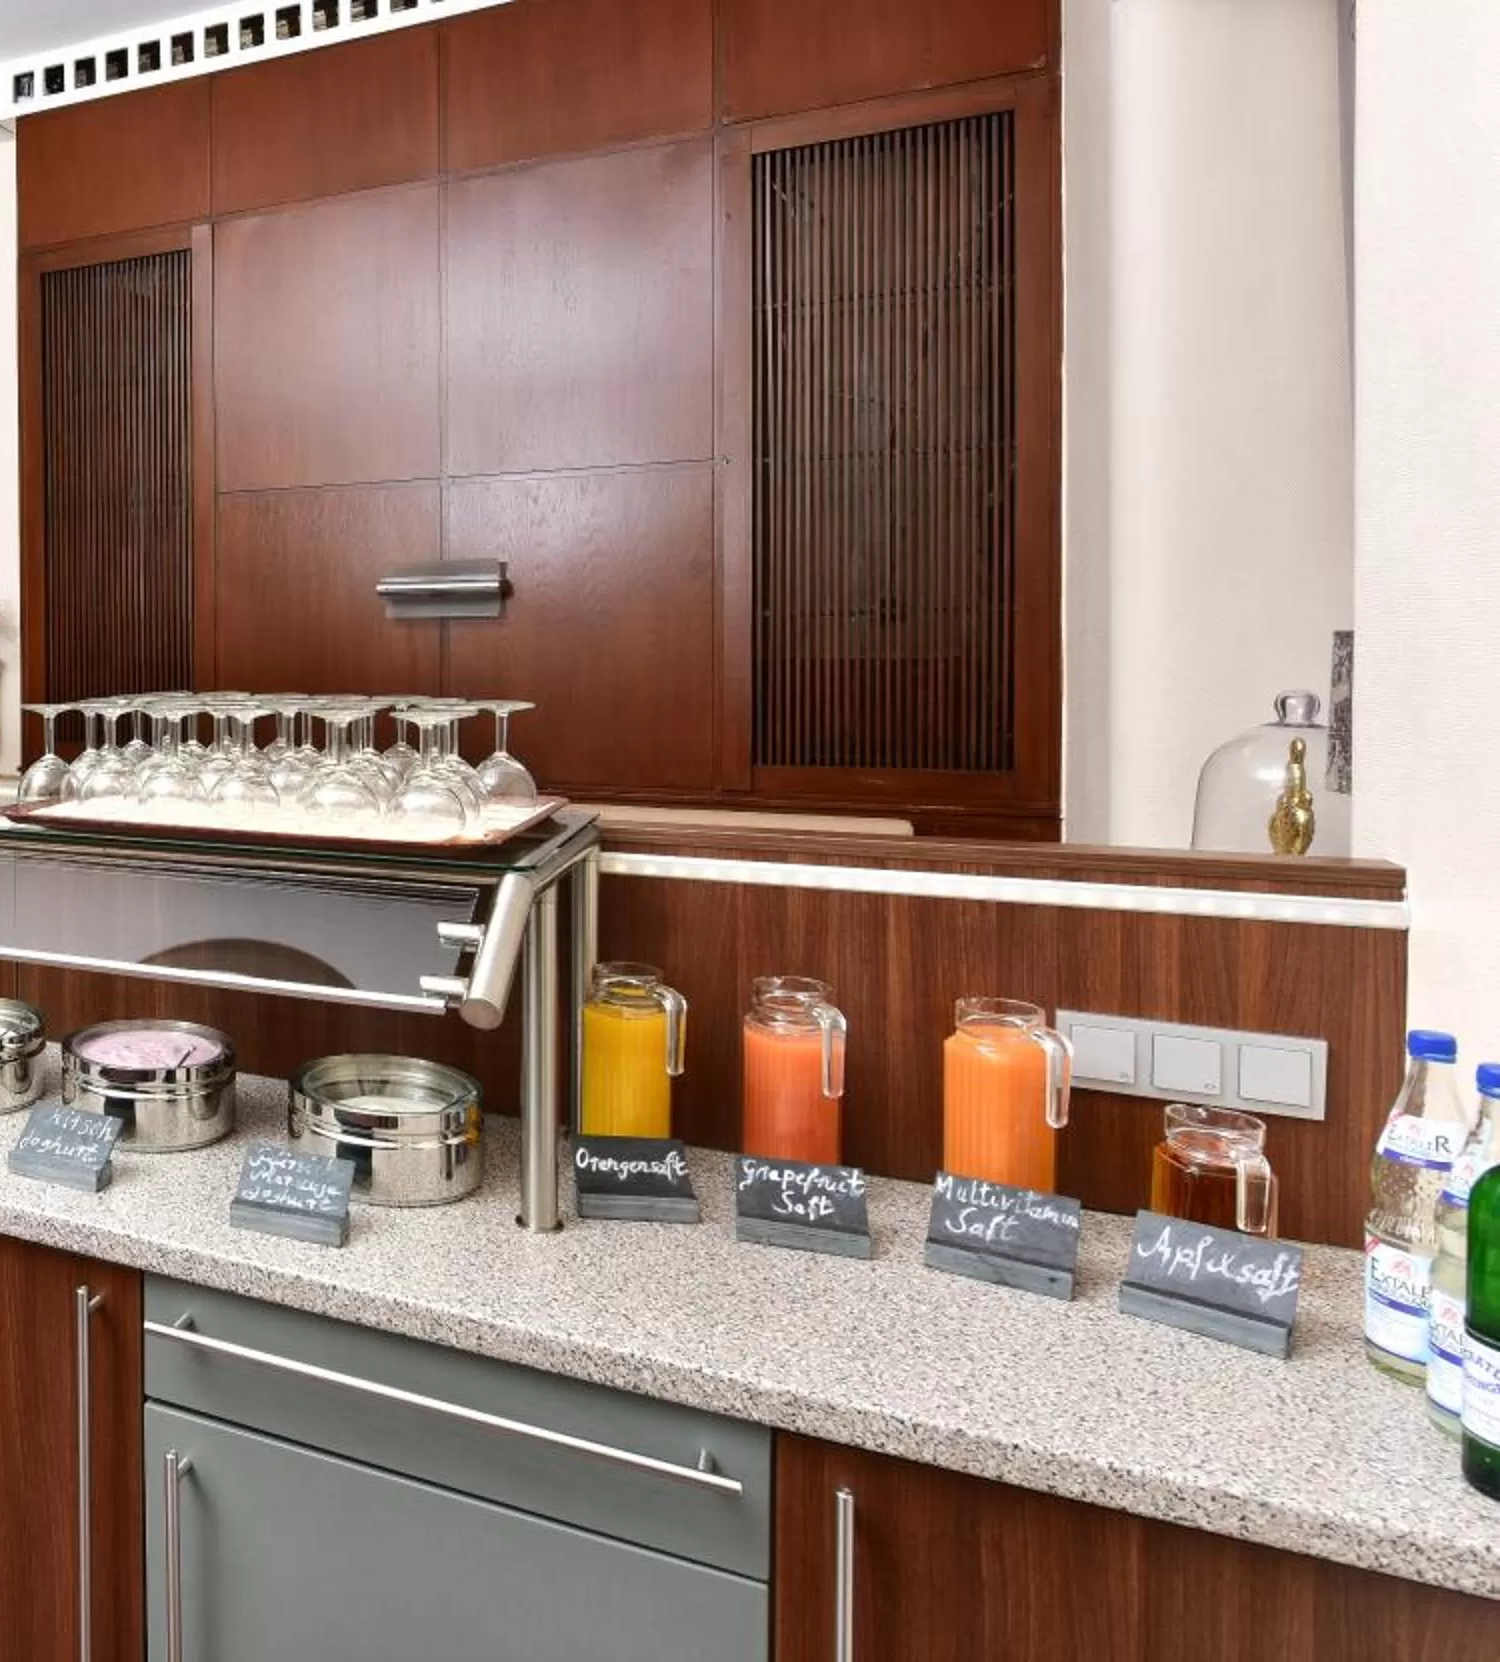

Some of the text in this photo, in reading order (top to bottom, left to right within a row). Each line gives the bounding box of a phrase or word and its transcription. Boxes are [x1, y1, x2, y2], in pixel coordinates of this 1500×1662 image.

[739, 1158, 866, 1198] Grapefruit
[772, 1191, 836, 1222] Saft
[934, 1174, 1080, 1229] Multivitamin
[944, 1206, 1021, 1244] Saft
